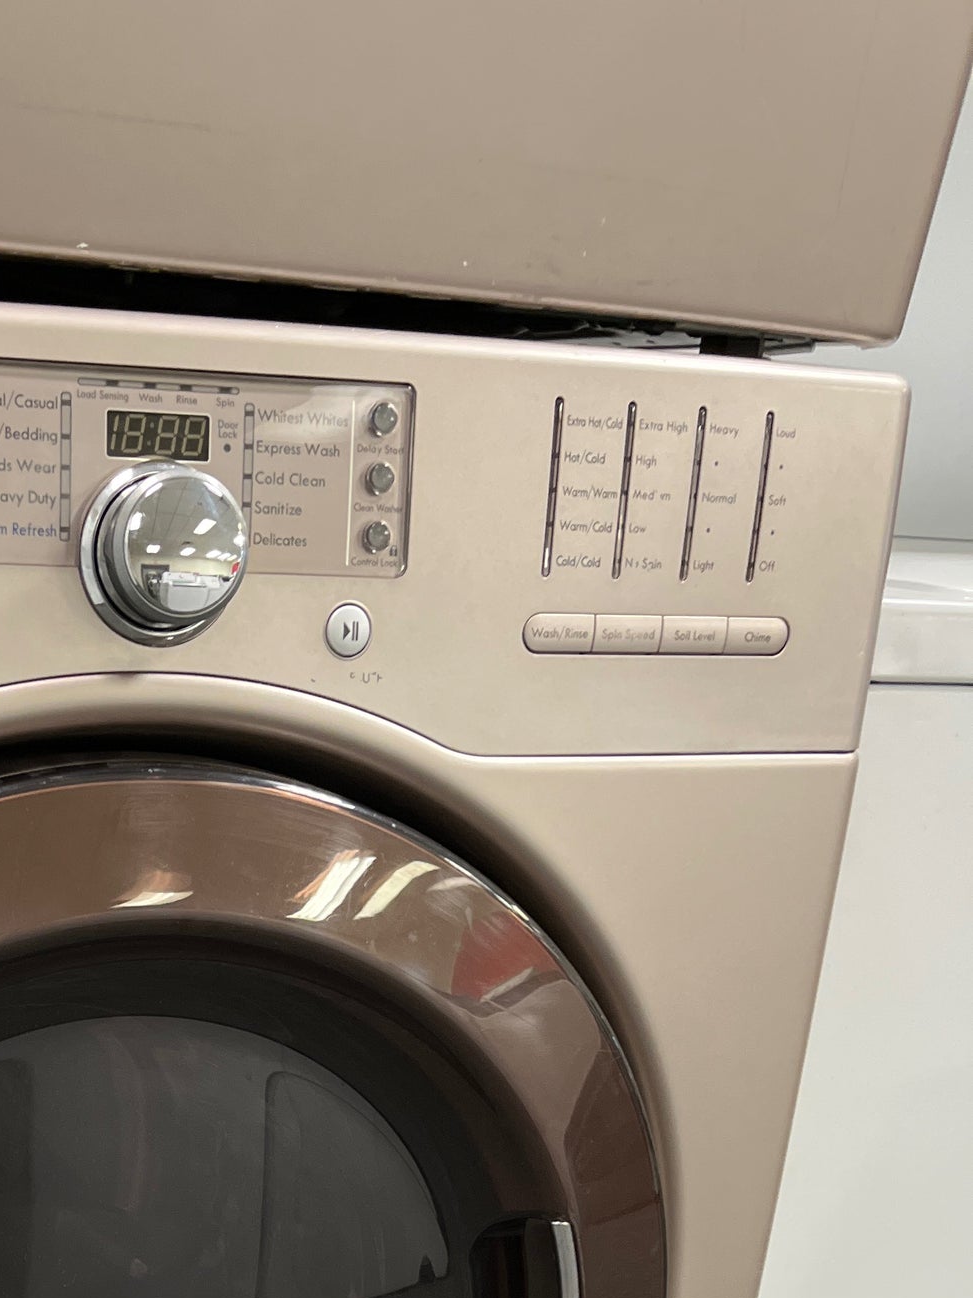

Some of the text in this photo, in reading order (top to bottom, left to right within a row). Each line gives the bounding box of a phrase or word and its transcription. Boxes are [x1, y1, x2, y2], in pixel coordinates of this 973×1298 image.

[77, 390, 129, 403] Load Sensing
[139, 393, 163, 403] Wash
[176, 395, 197, 405] Rinse
[216, 398, 235, 408] Spin
[218, 420, 239, 430] Door
[258, 409, 348, 428] Whitest Whites
[567, 415, 623, 430] Extra Hot/Cold
[218, 430, 237, 439] Lock
[639, 420, 688, 436] Extra High
[709, 423, 739, 438] Heavy
[776, 427, 796, 439] Loud
[256, 441, 340, 457] Express Wash
[357, 444, 382, 458] Delay
[564, 452, 606, 465] Hot/Cold
[635, 455, 657, 469] High
[17, 459, 57, 474] Wear
[255, 472, 326, 488] Cold Clean
[563, 485, 617, 500] Warm/Warm
[702, 492, 736, 505] Normal
[28, 491, 57, 509] Duty
[768, 494, 786, 507] Soft
[254, 501, 303, 517] Sanitize
[353, 502, 374, 513] Clean
[12, 523, 57, 538] Refresh
[559, 520, 613, 533] Warm/Cold
[628, 523, 647, 533] Low
[253, 533, 307, 548] Delicates
[350, 557, 378, 568] Control
[555, 554, 601, 568] Cold/Cold
[693, 560, 714, 573] Light
[758, 560, 775, 571] Off
[531, 626, 589, 641] Wash/Rinse
[601, 628, 621, 641] Spin
[674, 630, 716, 642] Soil Level
